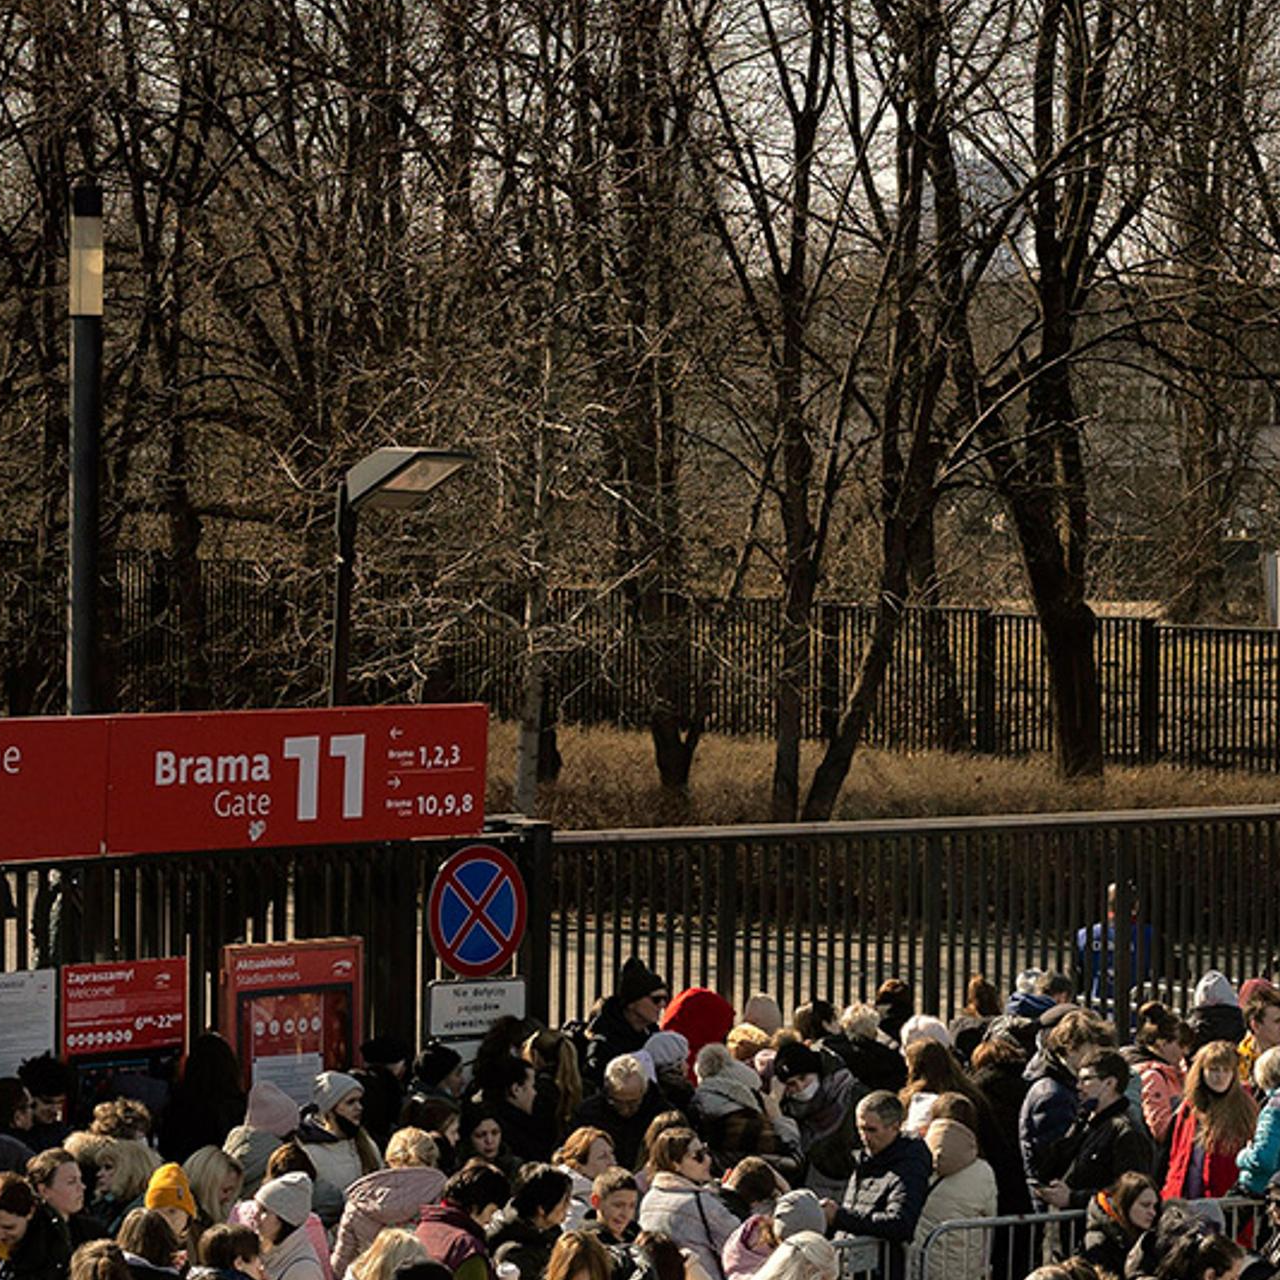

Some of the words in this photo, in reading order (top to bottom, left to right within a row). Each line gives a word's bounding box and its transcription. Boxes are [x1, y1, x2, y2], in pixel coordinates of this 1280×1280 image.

[419, 744, 461, 769] 1,2,3
[154, 751, 272, 786] Brama
[283, 734, 367, 821] 11
[214, 789, 272, 818] Gate
[417, 793, 474, 817] 10,9,8
[67, 968, 135, 986] Zapraszamy!
[237, 973, 274, 986] Stadium
[67, 985, 115, 999] Welcome!
